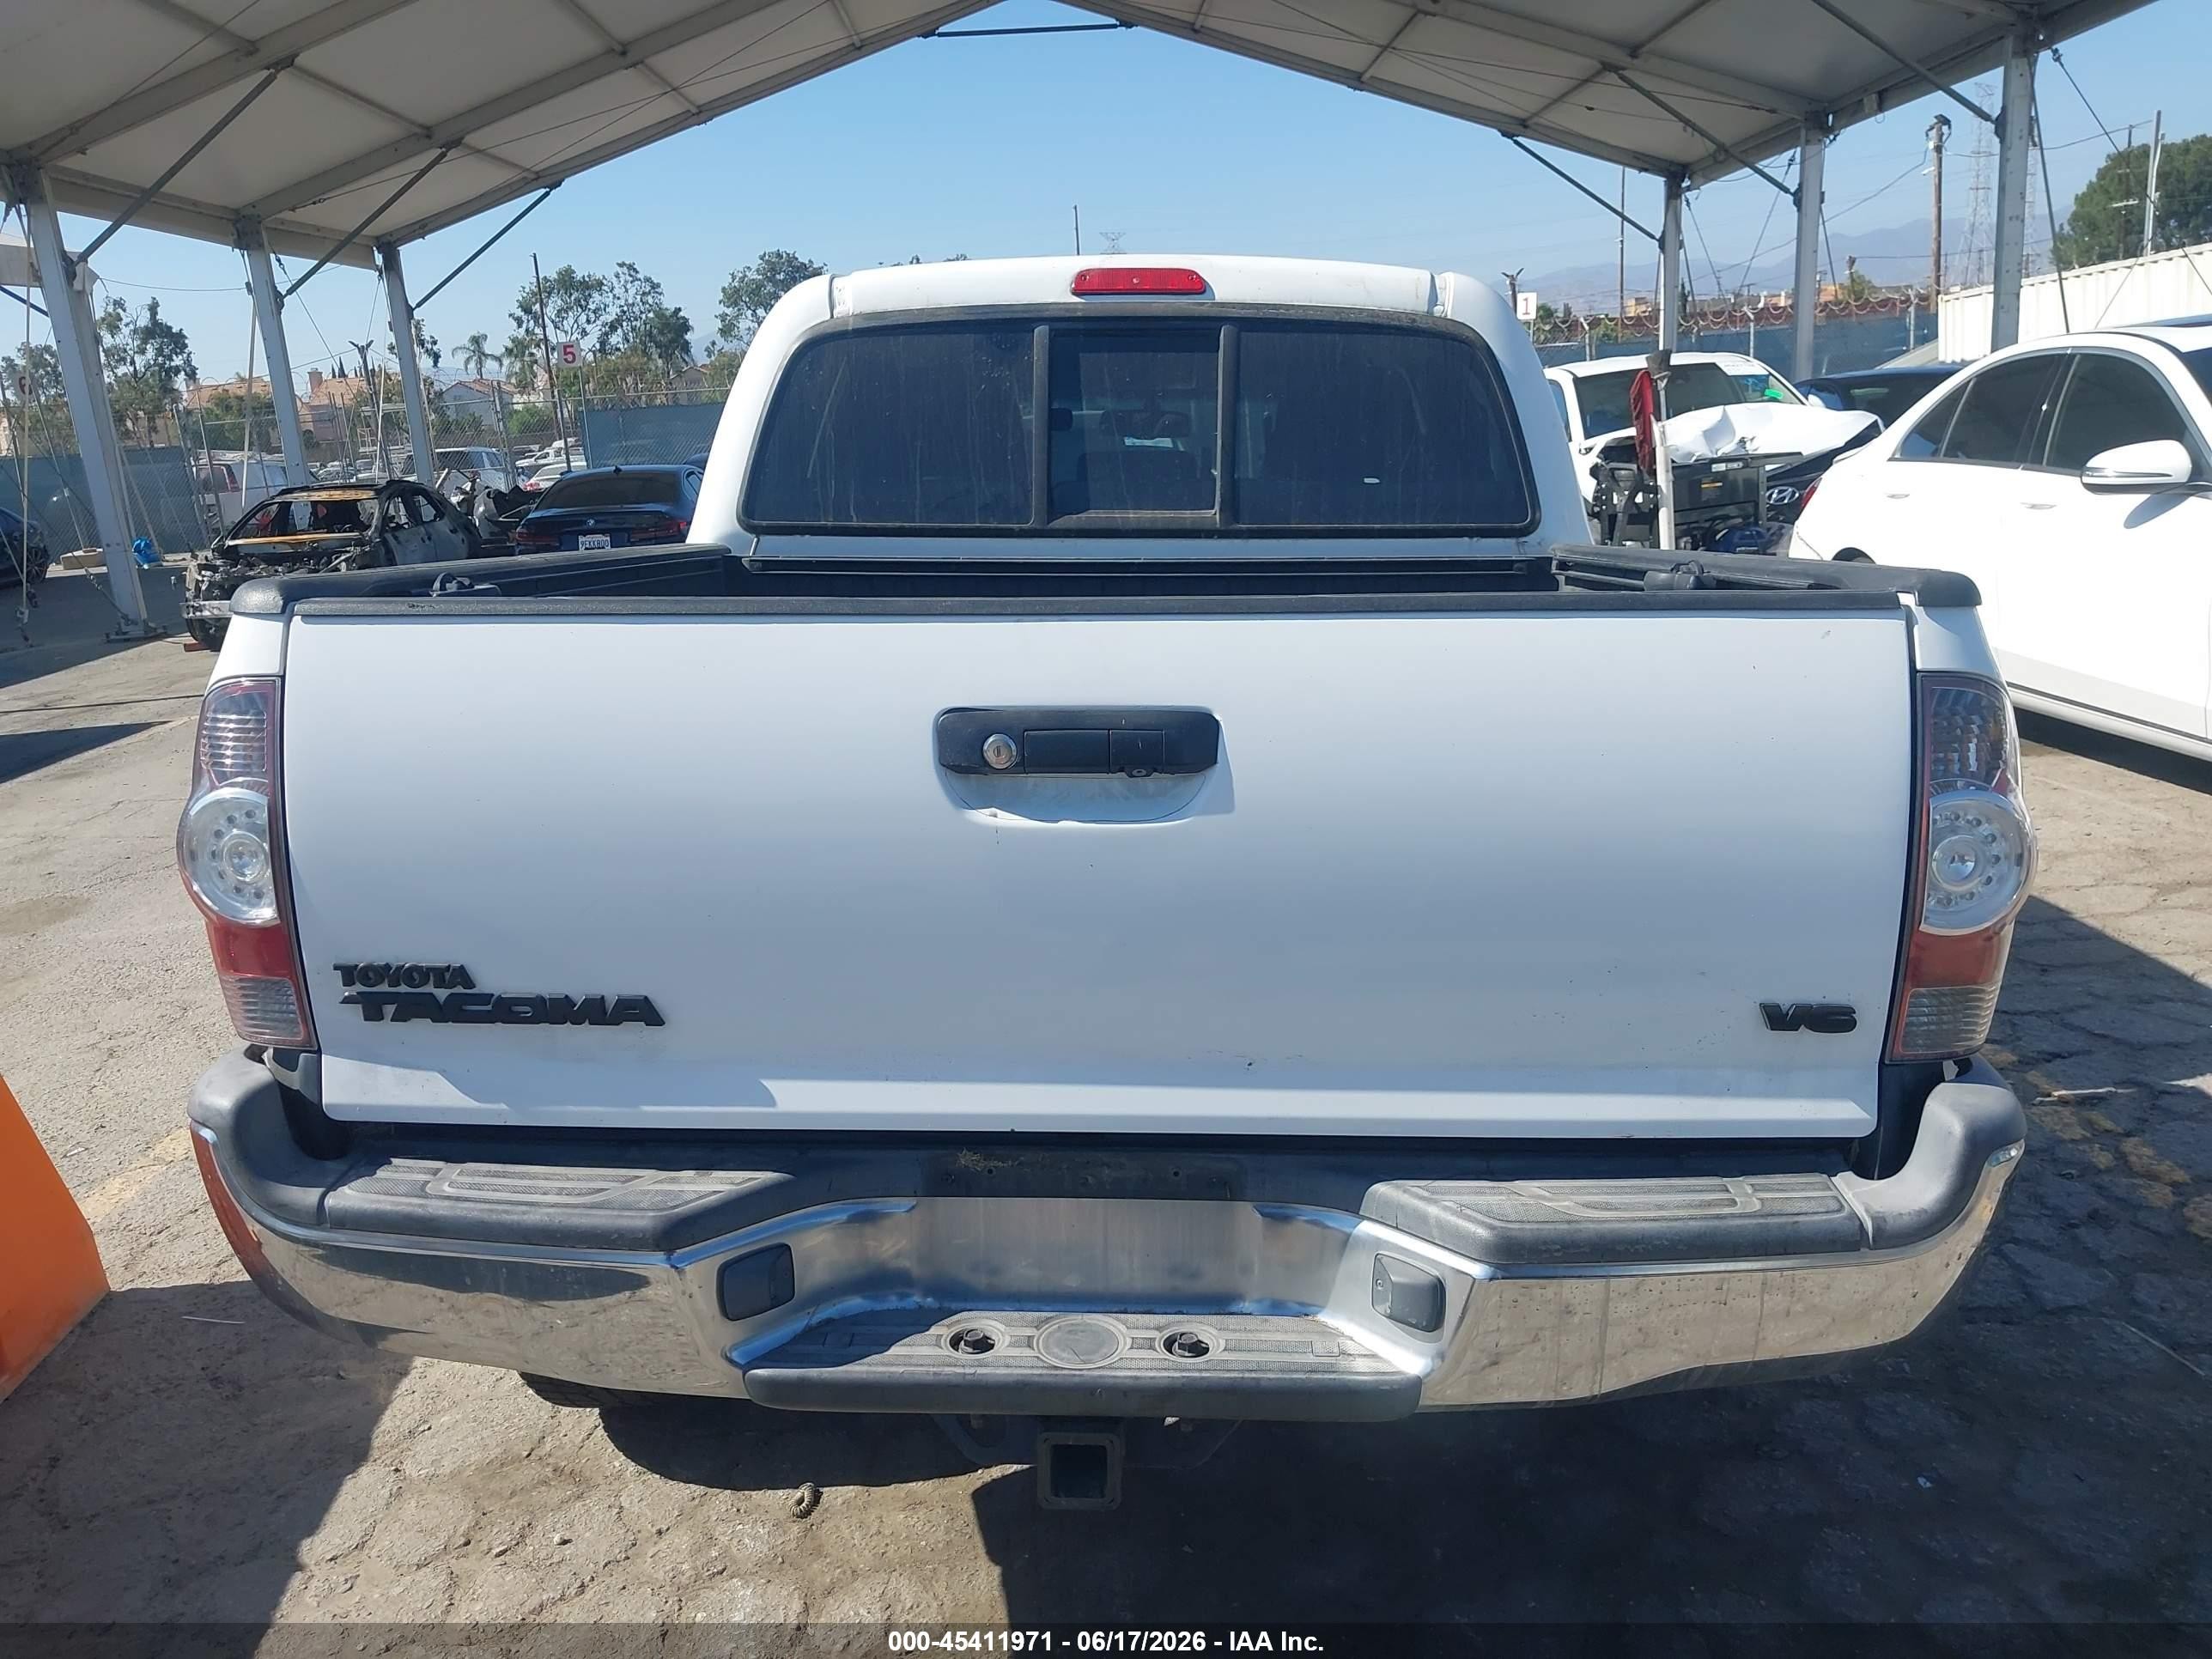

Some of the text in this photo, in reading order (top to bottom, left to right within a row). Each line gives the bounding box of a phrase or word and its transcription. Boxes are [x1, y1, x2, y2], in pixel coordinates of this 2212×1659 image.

[1522, 297, 1530, 315] 1
[563, 344, 576, 364] 5
[333, 963, 476, 989] TOYOTA
[339, 991, 665, 1026] TACOMA
[1759, 1003, 1856, 1033] V6
